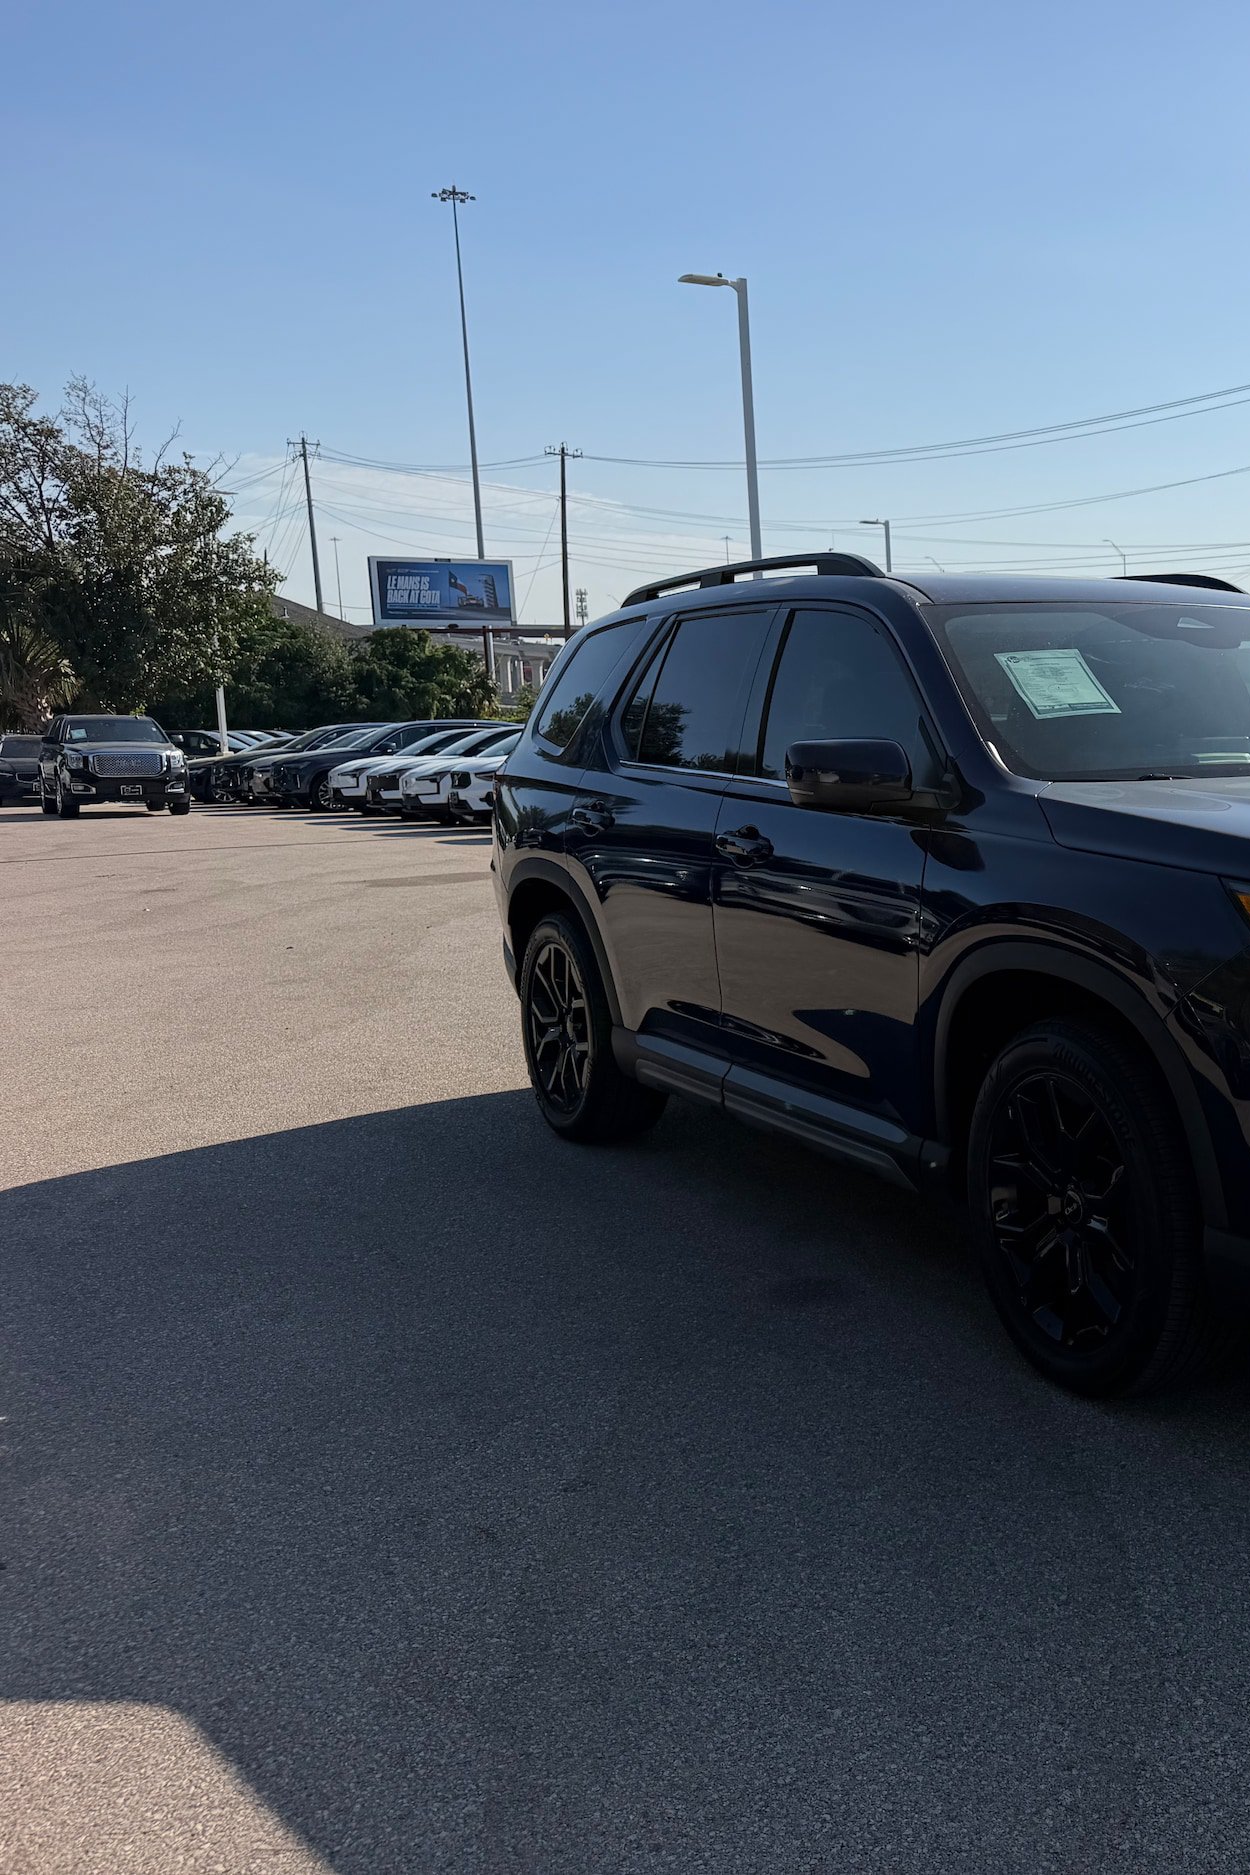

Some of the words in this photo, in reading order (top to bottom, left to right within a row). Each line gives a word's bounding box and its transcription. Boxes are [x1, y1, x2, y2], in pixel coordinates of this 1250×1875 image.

[387, 576, 397, 589] LE
[397, 576, 420, 589] MANS
[420, 576, 430, 590] IS
[387, 590, 410, 603] BACK
[410, 590, 420, 603] AT
[420, 591, 440, 604] COTA
